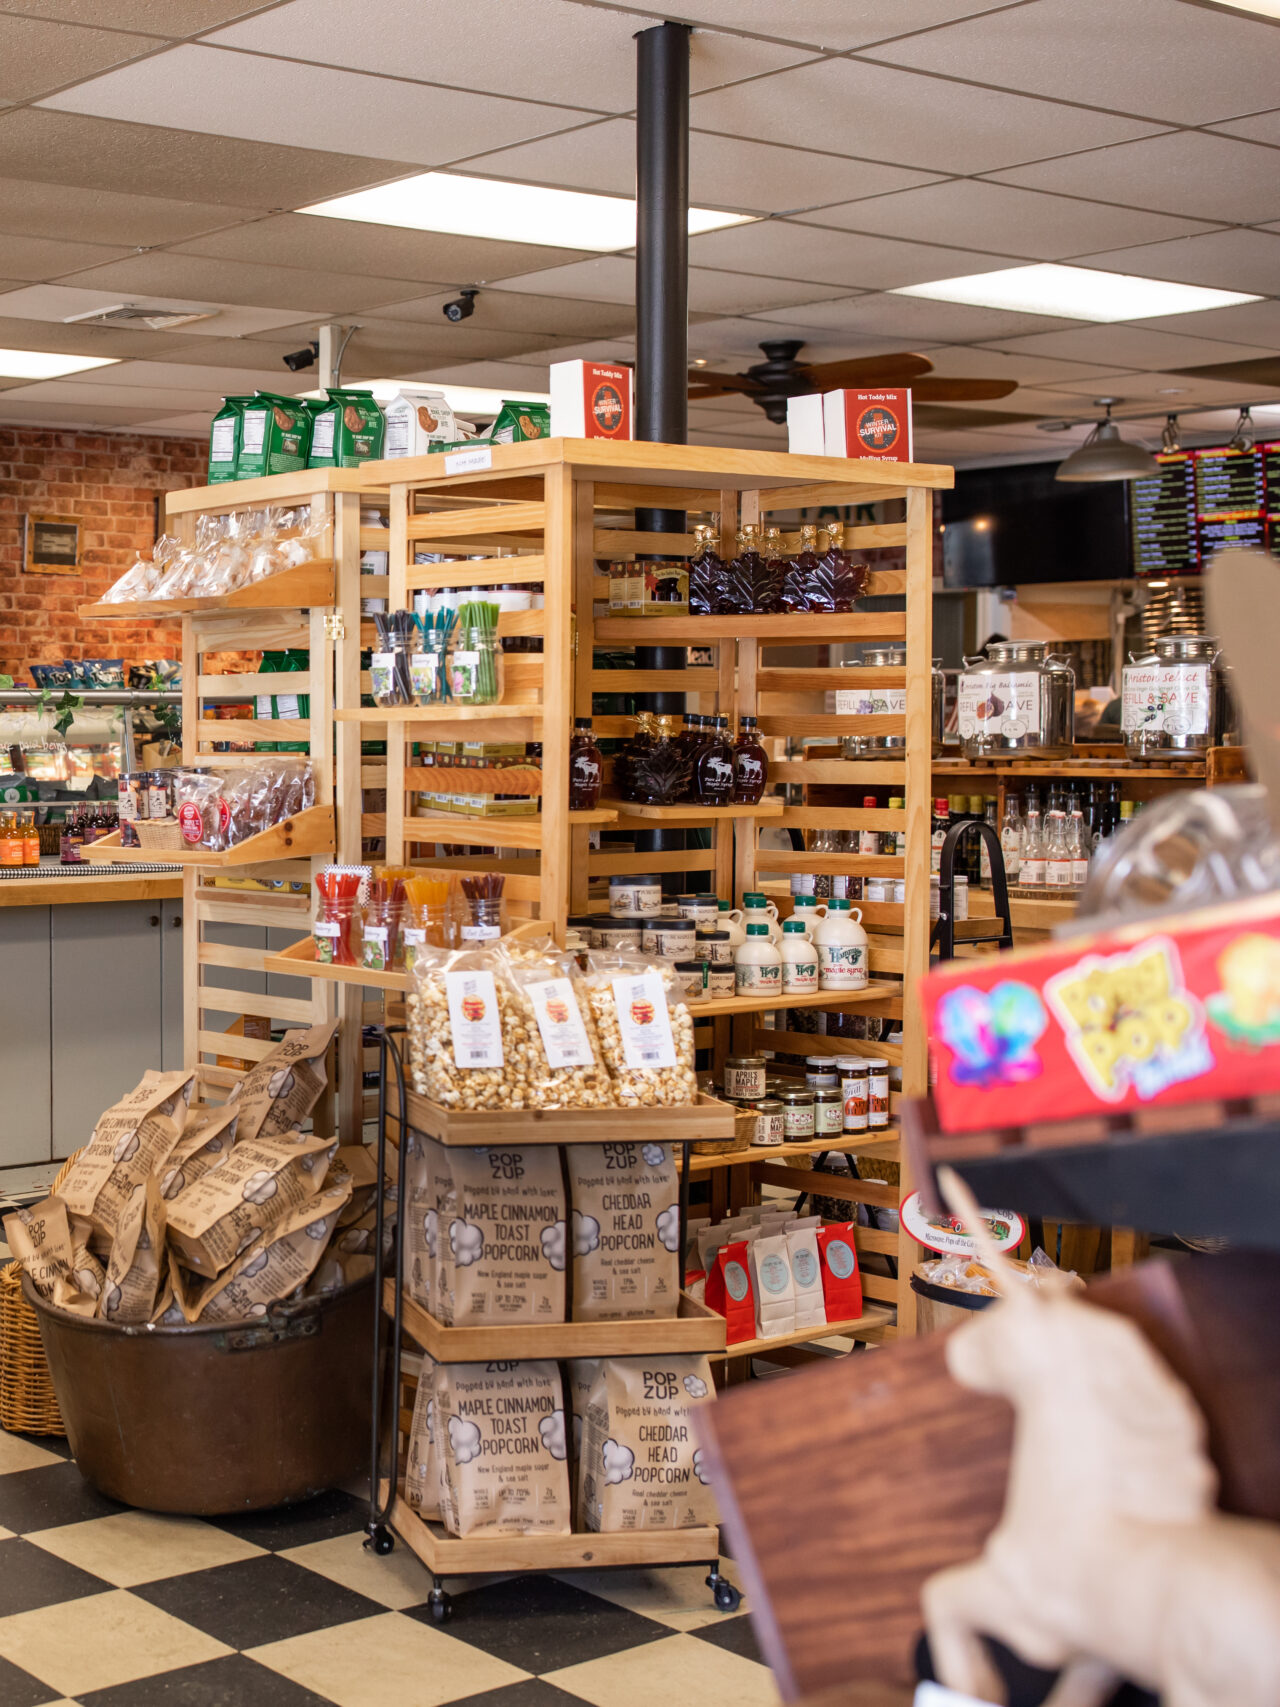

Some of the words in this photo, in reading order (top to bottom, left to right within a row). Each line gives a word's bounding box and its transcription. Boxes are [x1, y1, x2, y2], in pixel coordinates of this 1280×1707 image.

[601, 369, 614, 379] Toddy
[598, 398, 617, 406] WINTER
[592, 405, 622, 414] SURVIVAL
[866, 418, 889, 428] WINTER
[858, 424, 897, 437] SURVIVAL
[1147, 692, 1155, 704] &
[40, 736, 68, 752] being
[824, 967, 845, 975] maple
[847, 967, 864, 976] syrup
[735, 1071, 758, 1079] APRIL'S
[735, 1078, 758, 1086] MAPLE
[603, 1142, 636, 1156] POP
[488, 1153, 523, 1167] POP
[605, 1155, 638, 1169] ZUP
[492, 1167, 525, 1180] ZUP
[617, 1175, 633, 1186] hand
[634, 1174, 650, 1185] with
[502, 1184, 520, 1196] hand
[522, 1185, 538, 1196] with
[602, 1193, 652, 1211] CHEDDAR
[463, 1203, 498, 1220] MAPLE
[500, 1204, 559, 1222] CINNAMON
[28, 1220, 46, 1234] POP
[613, 1214, 643, 1231] HEAD
[494, 1223, 530, 1242] TOAST
[600, 1233, 655, 1251] POPCORN
[483, 1244, 539, 1261] POPCORN
[600, 1258, 613, 1266] Real
[614, 1258, 635, 1266] cheddar
[477, 1270, 489, 1278] New
[491, 1270, 512, 1279] England
[514, 1271, 531, 1280] maple
[533, 1271, 548, 1280] sugar
[612, 1267, 617, 1275] &
[630, 1267, 641, 1275] salt
[496, 1280, 502, 1288] &
[515, 1280, 526, 1288] salt
[485, 1361, 520, 1373] ZUP
[496, 1379, 514, 1390] hand
[517, 1378, 534, 1389] with
[642, 1372, 677, 1386] POP
[643, 1385, 679, 1400] ZUP
[458, 1398, 494, 1416] MAPLE
[495, 1396, 556, 1414] CINNAMON
[653, 1406, 671, 1416] hand
[490, 1417, 527, 1435] TOAST
[639, 1425, 688, 1442] CHEDDAR
[482, 1437, 539, 1455] POPCORN
[648, 1446, 678, 1463] HEAD
[477, 1465, 490, 1473] New
[491, 1464, 514, 1473] England
[515, 1465, 532, 1475] maple
[534, 1464, 550, 1473] sugar
[634, 1467, 691, 1484] POPCORN
[498, 1475, 503, 1483] &
[517, 1474, 529, 1482] salt
[632, 1489, 645, 1497] Real
[646, 1489, 669, 1497] cheddar
[643, 1499, 648, 1507] &
[522, 1517, 534, 1525] free
